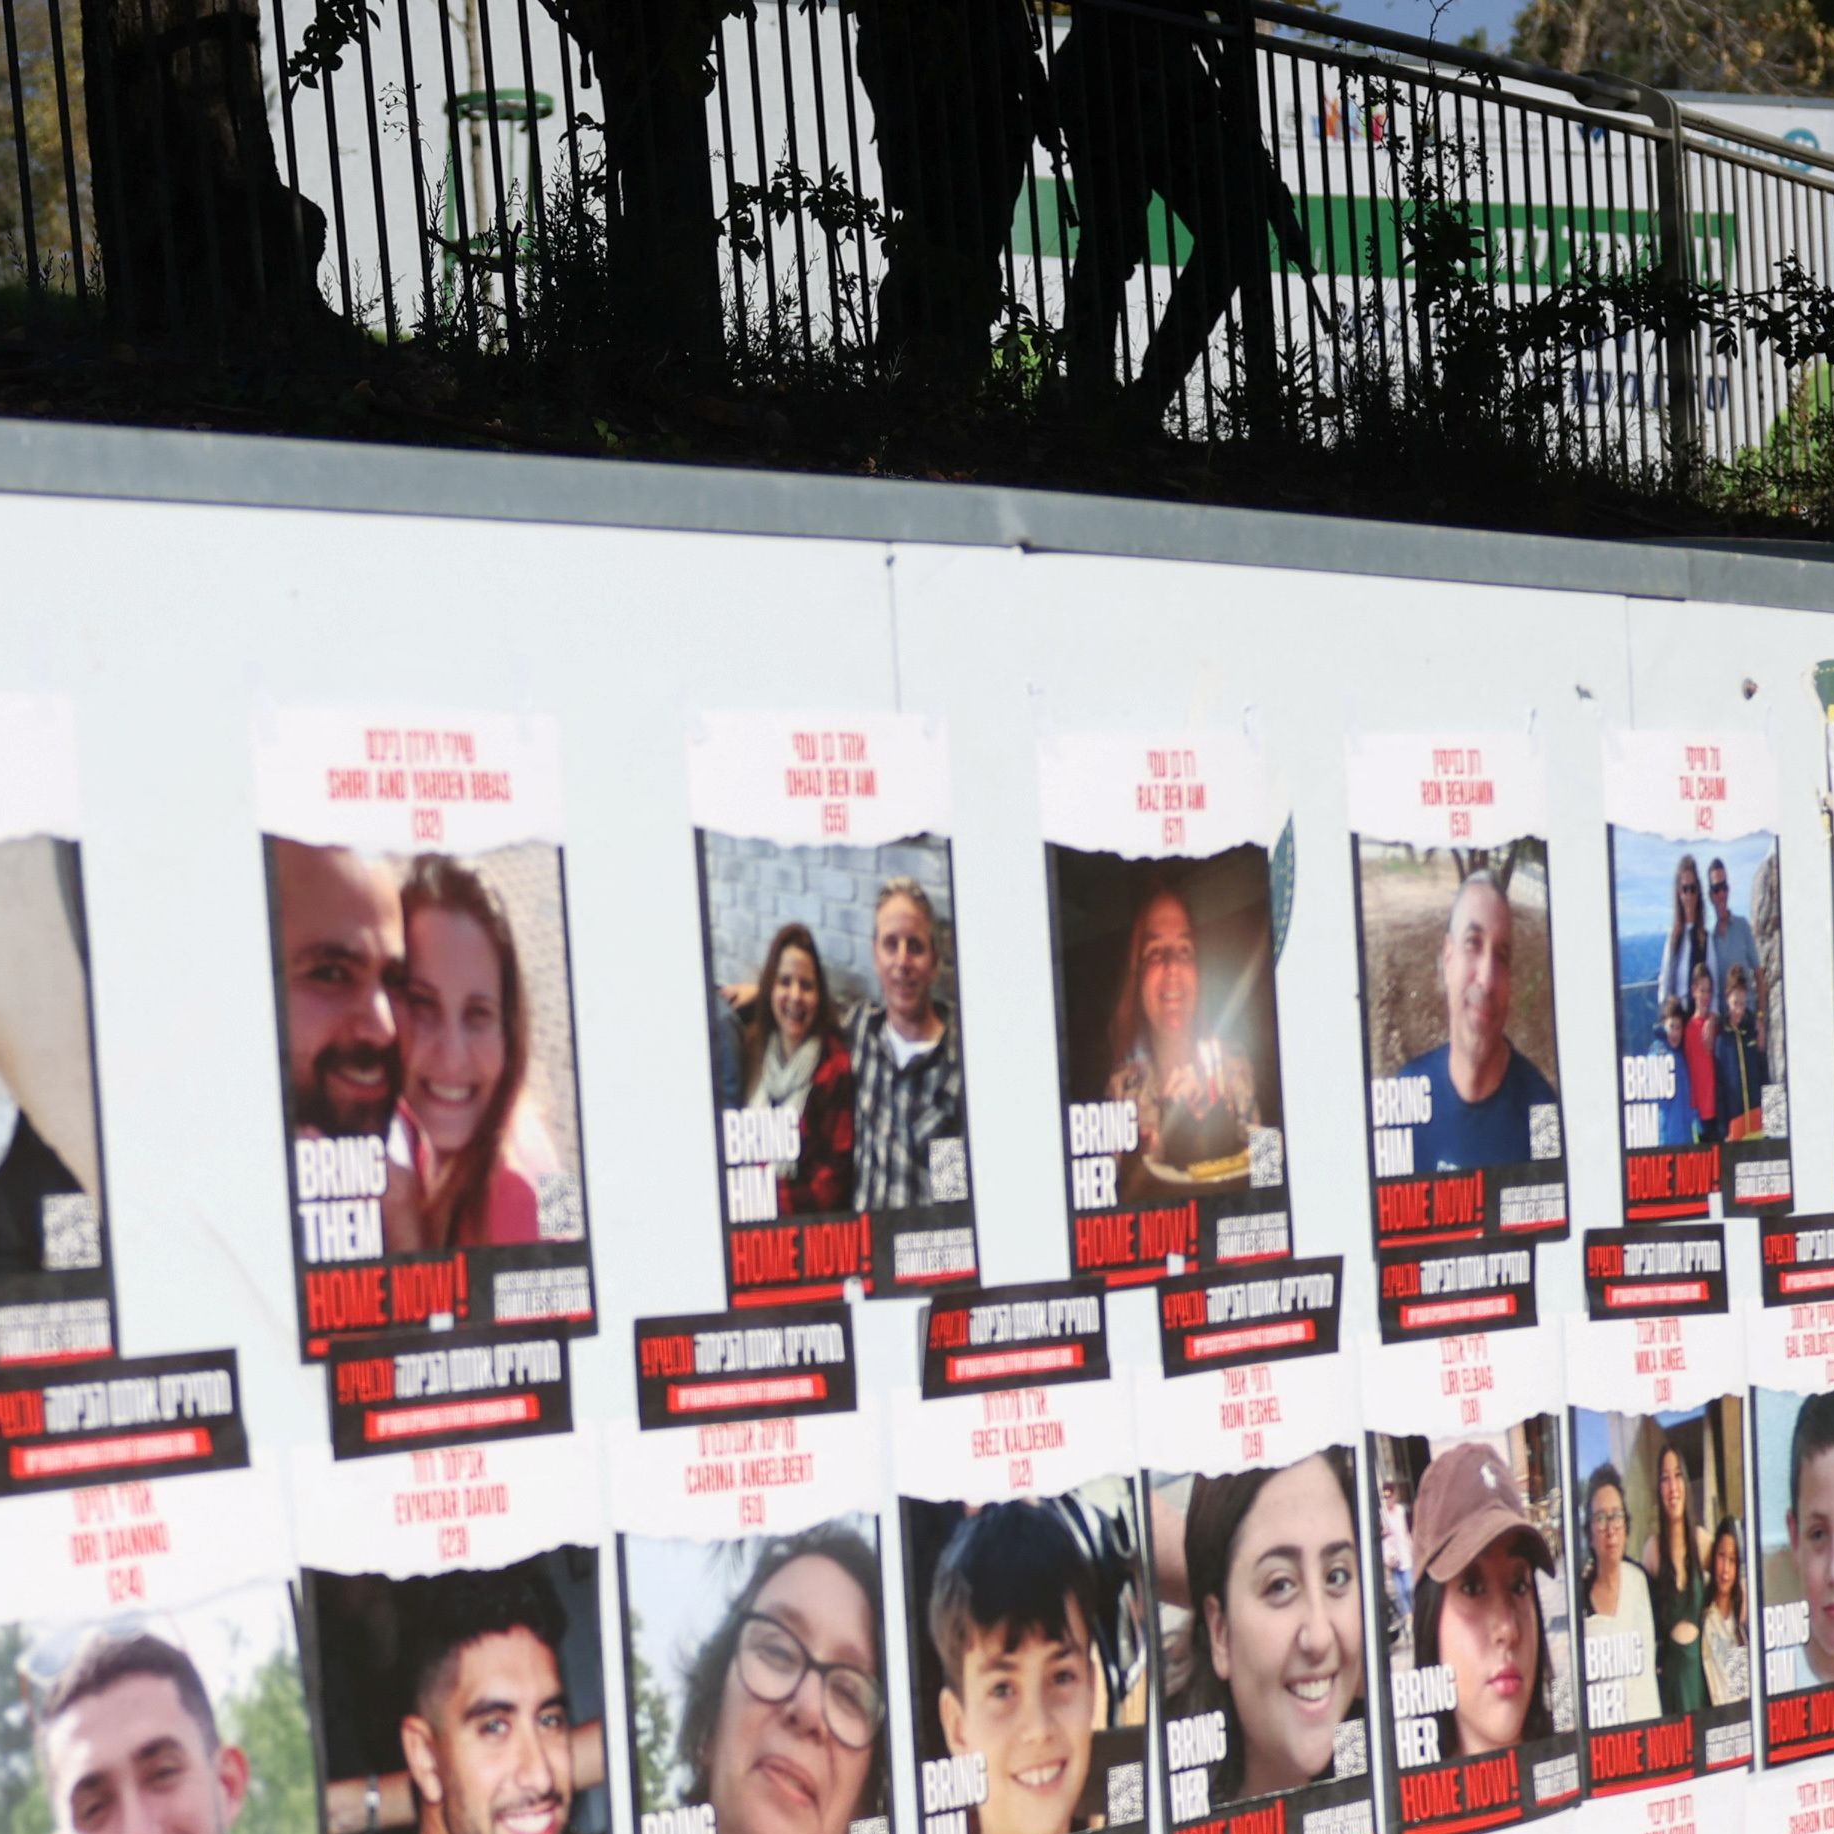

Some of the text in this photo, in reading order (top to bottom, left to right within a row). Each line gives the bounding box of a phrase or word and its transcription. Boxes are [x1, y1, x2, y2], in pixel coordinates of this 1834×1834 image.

[1680, 776, 1696, 798] TAL
[1622, 1056, 1675, 1100] BRING
[1070, 1101, 1138, 1155] BRING
[1626, 1104, 1659, 1149] HIM
[293, 1136, 387, 1199] BRING
[1072, 1157, 1116, 1209] HER
[1628, 1154, 1674, 1200] HOME
[1676, 1146, 1720, 1195] NOW!
[300, 1200, 383, 1261] THEM
[1075, 1217, 1134, 1266] HOME
[1139, 1201, 1198, 1260] NOW!
[306, 1271, 387, 1330] HOME
[392, 1254, 467, 1324] NOW!
